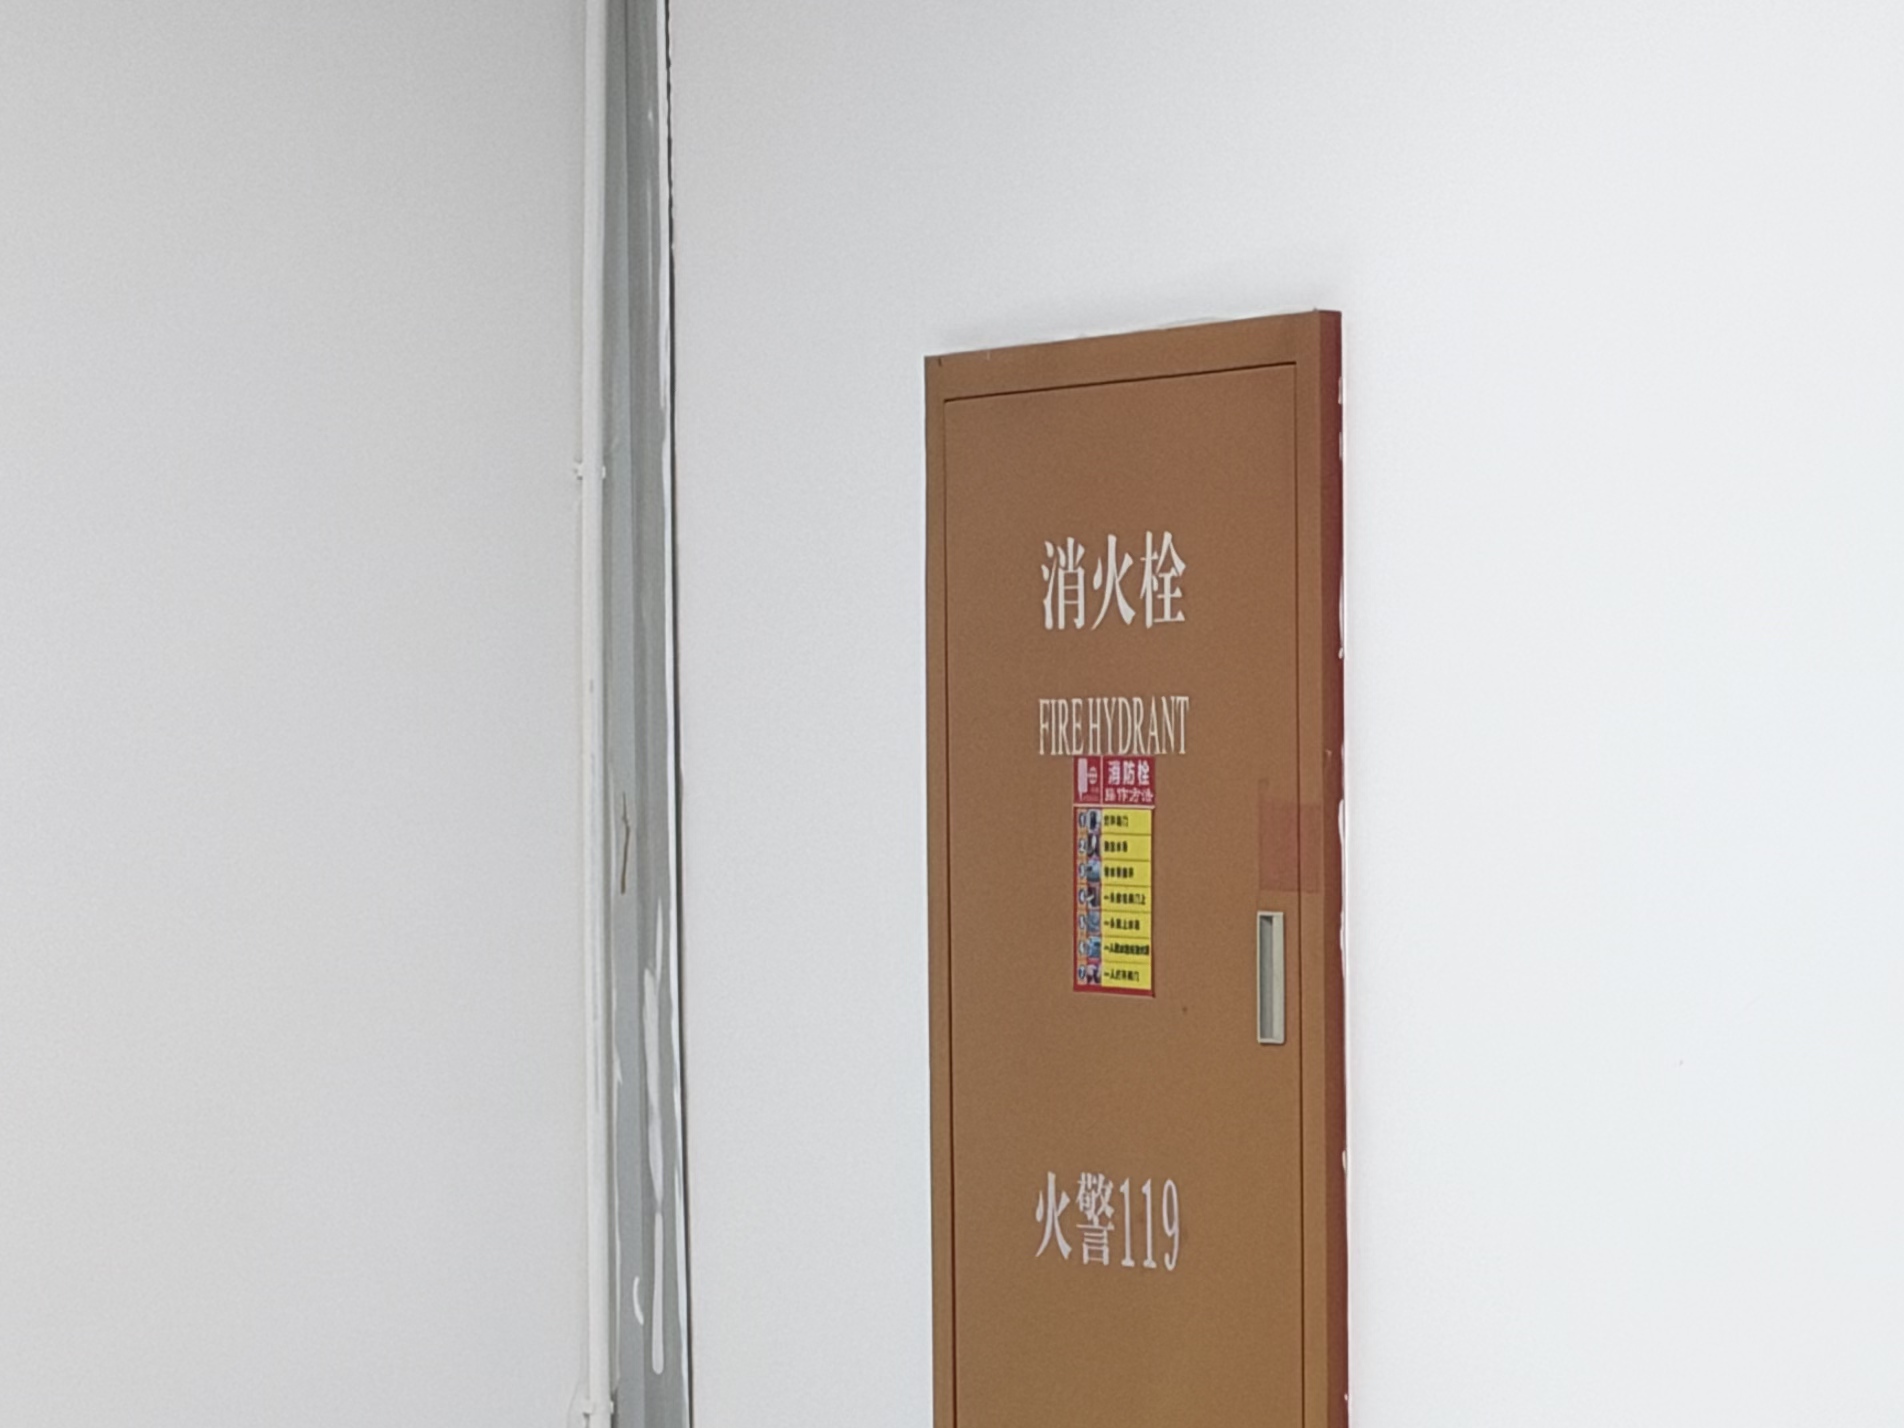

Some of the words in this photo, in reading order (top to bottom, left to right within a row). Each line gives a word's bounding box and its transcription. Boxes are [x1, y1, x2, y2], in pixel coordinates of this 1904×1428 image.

[1041, 531, 1186, 630] 消火栓
[1039, 698, 1084, 755] FIRE
[1087, 696, 1189, 755] HYDRANT
[1035, 1171, 1179, 1271] 火警119
